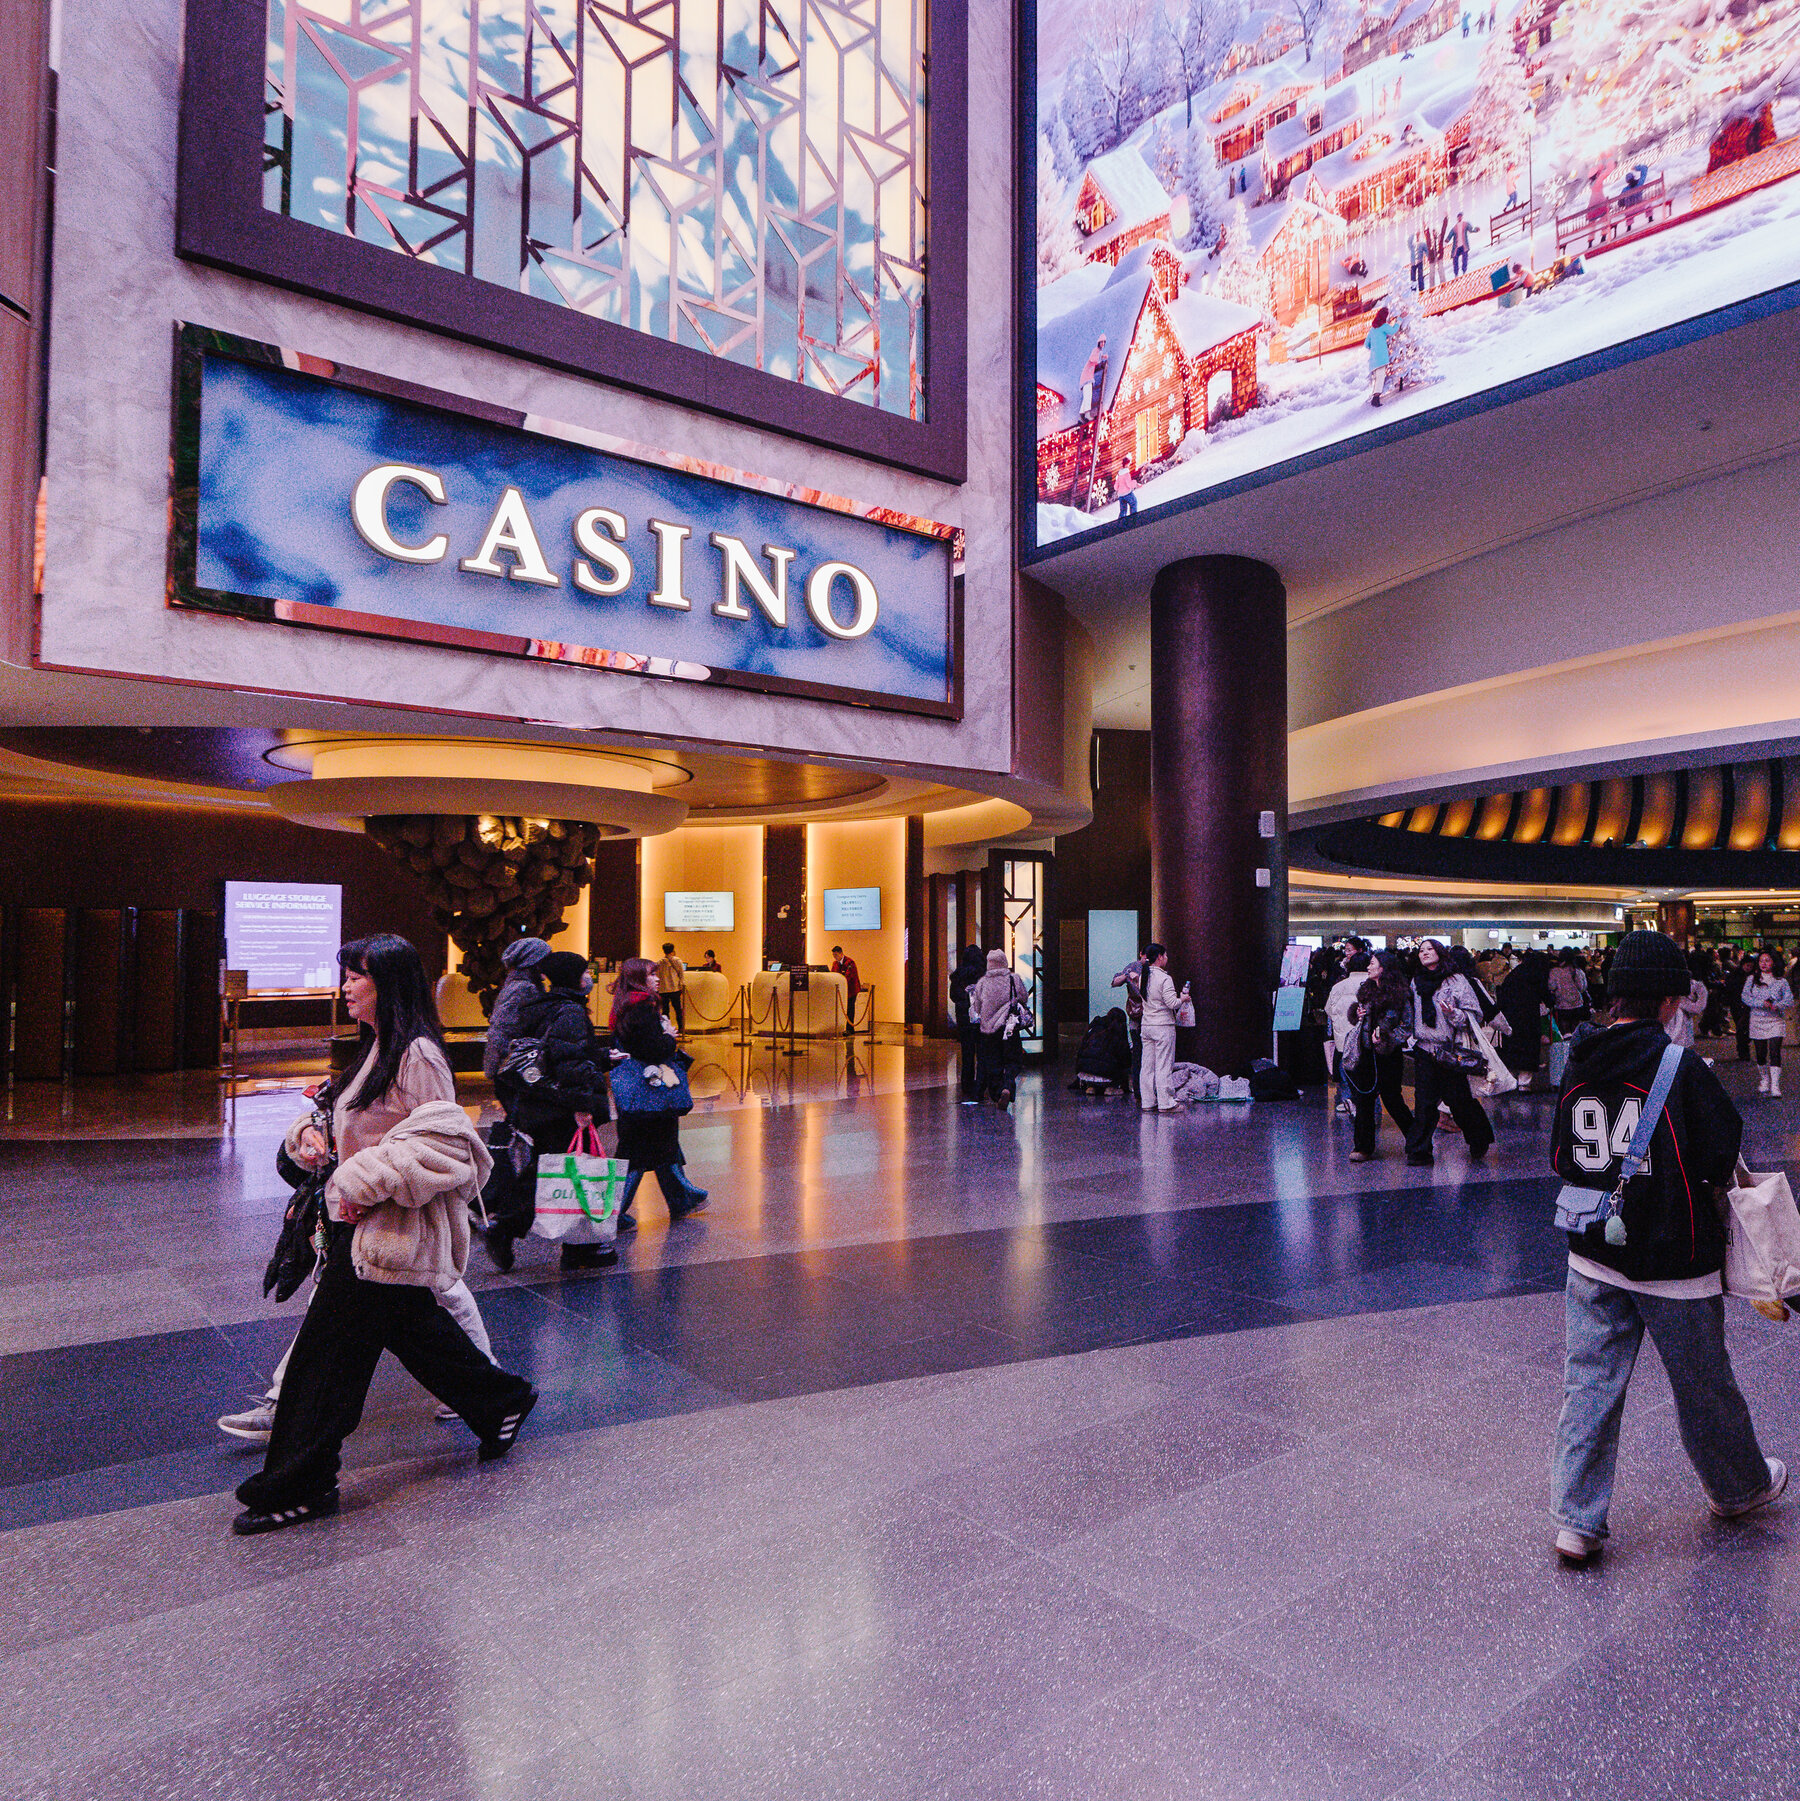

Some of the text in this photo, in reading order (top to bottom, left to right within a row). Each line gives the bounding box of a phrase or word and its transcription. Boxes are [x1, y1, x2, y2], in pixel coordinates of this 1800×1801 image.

[351, 462, 879, 640] CASINO
[235, 901, 333, 910] SERVICE INFORMATION
[243, 893, 327, 902] LUGGAGE STORAGE
[1572, 1096, 1651, 1176] 94
